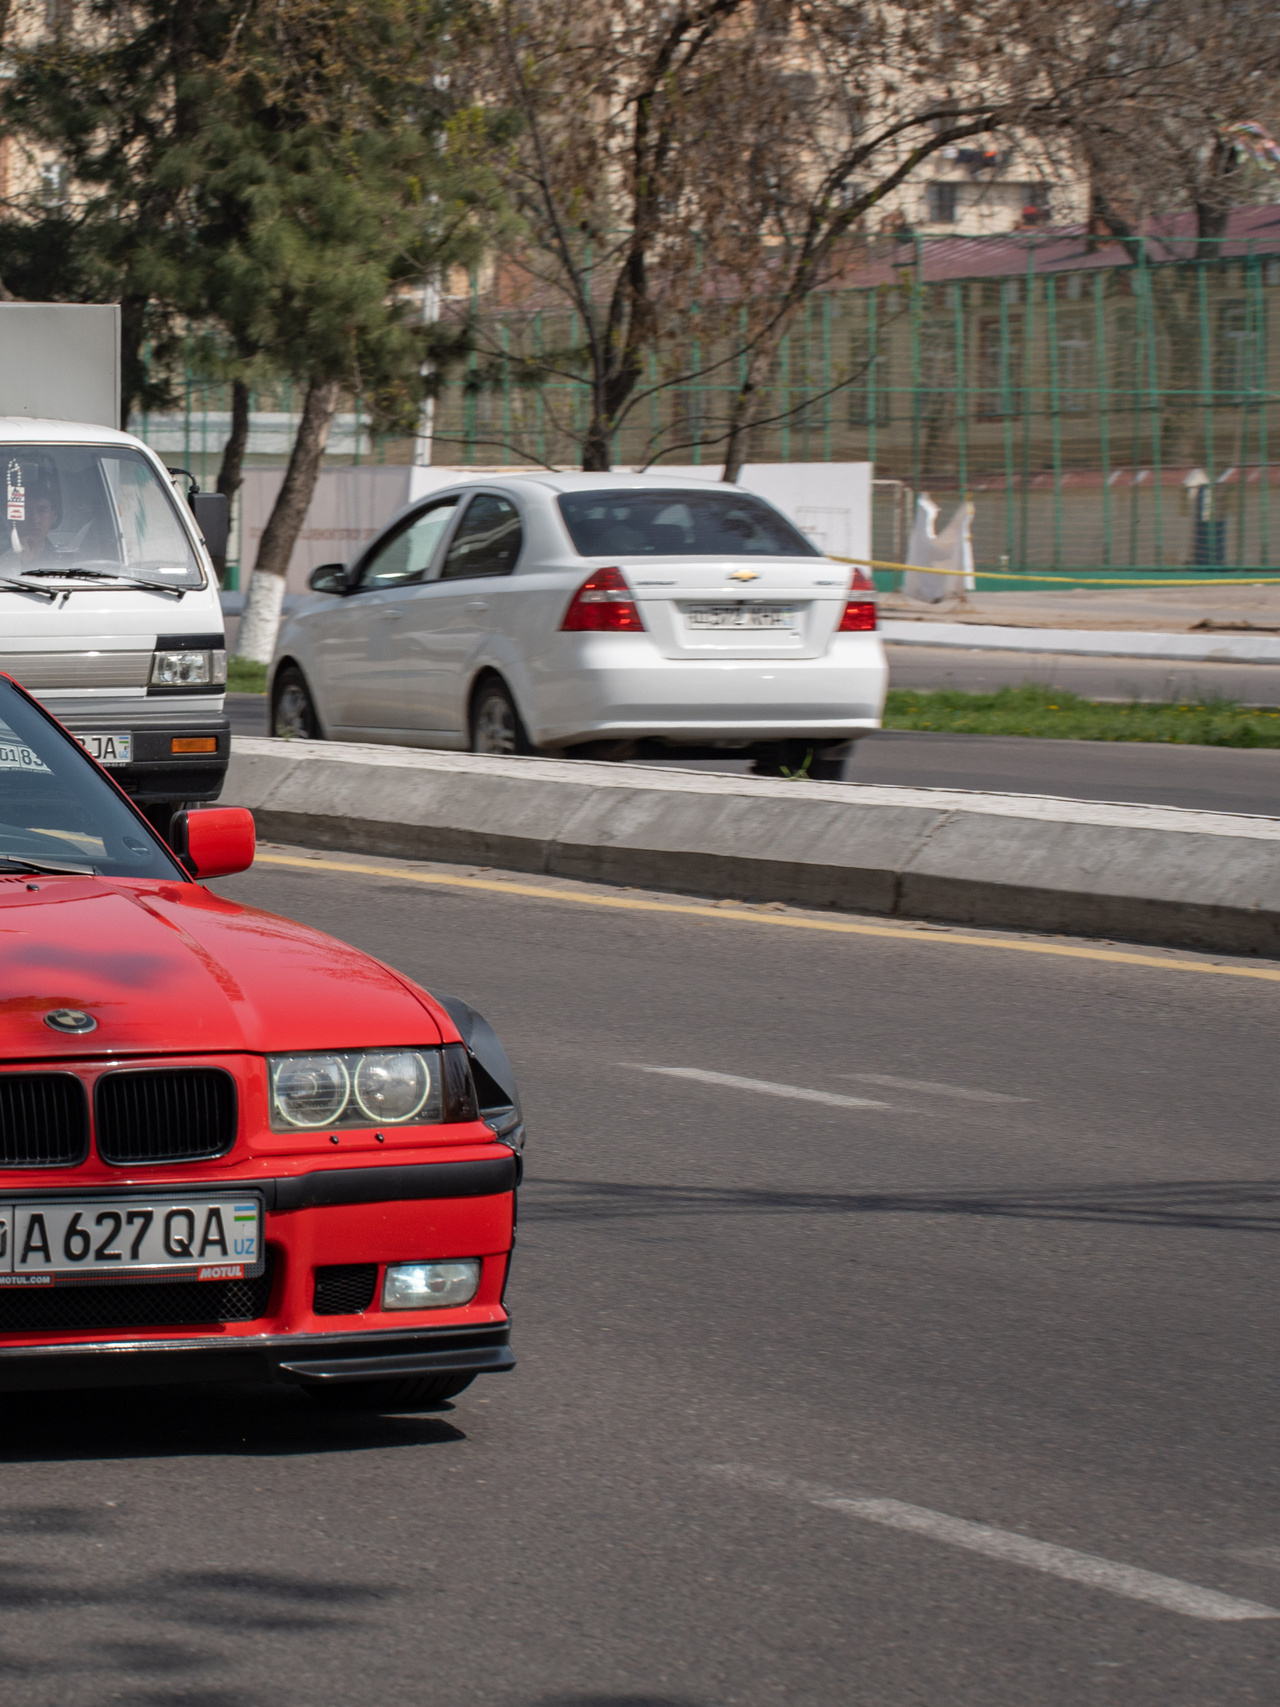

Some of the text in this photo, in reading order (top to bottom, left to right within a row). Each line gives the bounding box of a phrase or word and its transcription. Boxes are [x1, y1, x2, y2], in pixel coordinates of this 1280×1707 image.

[0, 747, 18, 762] 01
[20, 1212, 52, 1264] A
[63, 1208, 154, 1262] 627
[163, 1205, 229, 1258] QA
[233, 1238, 255, 1255] UZ
[199, 1265, 243, 1279] MOTUL
